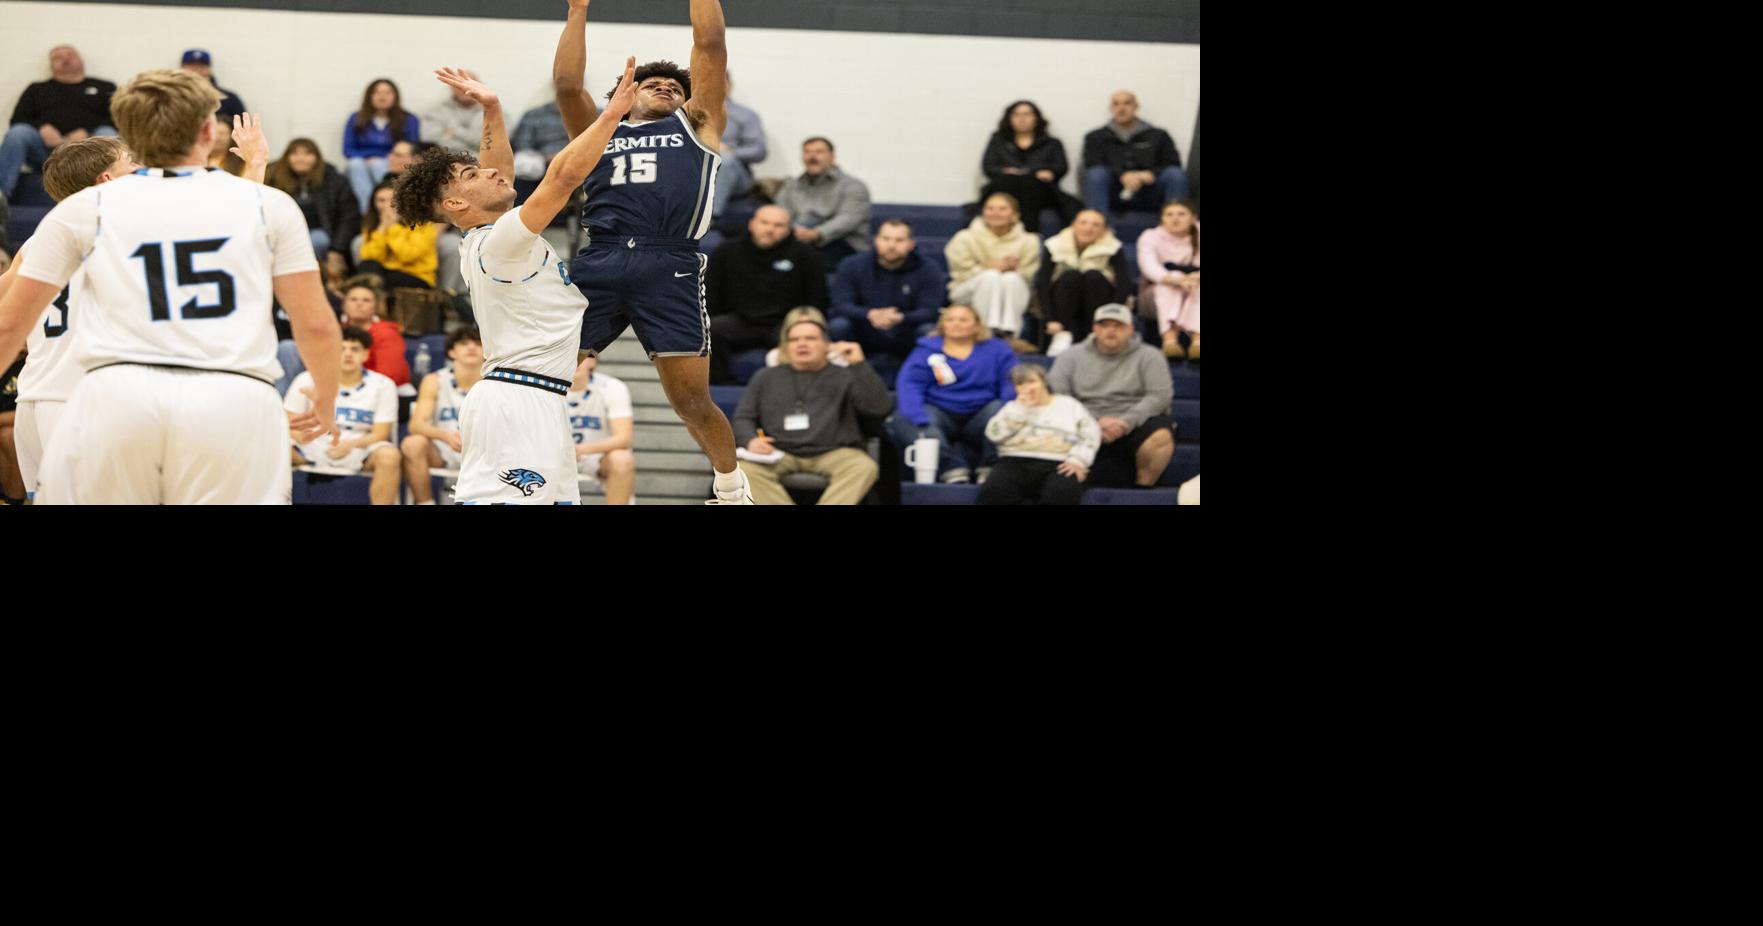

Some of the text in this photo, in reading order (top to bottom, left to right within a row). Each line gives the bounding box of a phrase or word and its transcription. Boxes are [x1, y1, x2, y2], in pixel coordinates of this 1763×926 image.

[603, 133, 685, 155] ERMITS
[609, 152, 658, 187] 15
[128, 236, 237, 322] 15
